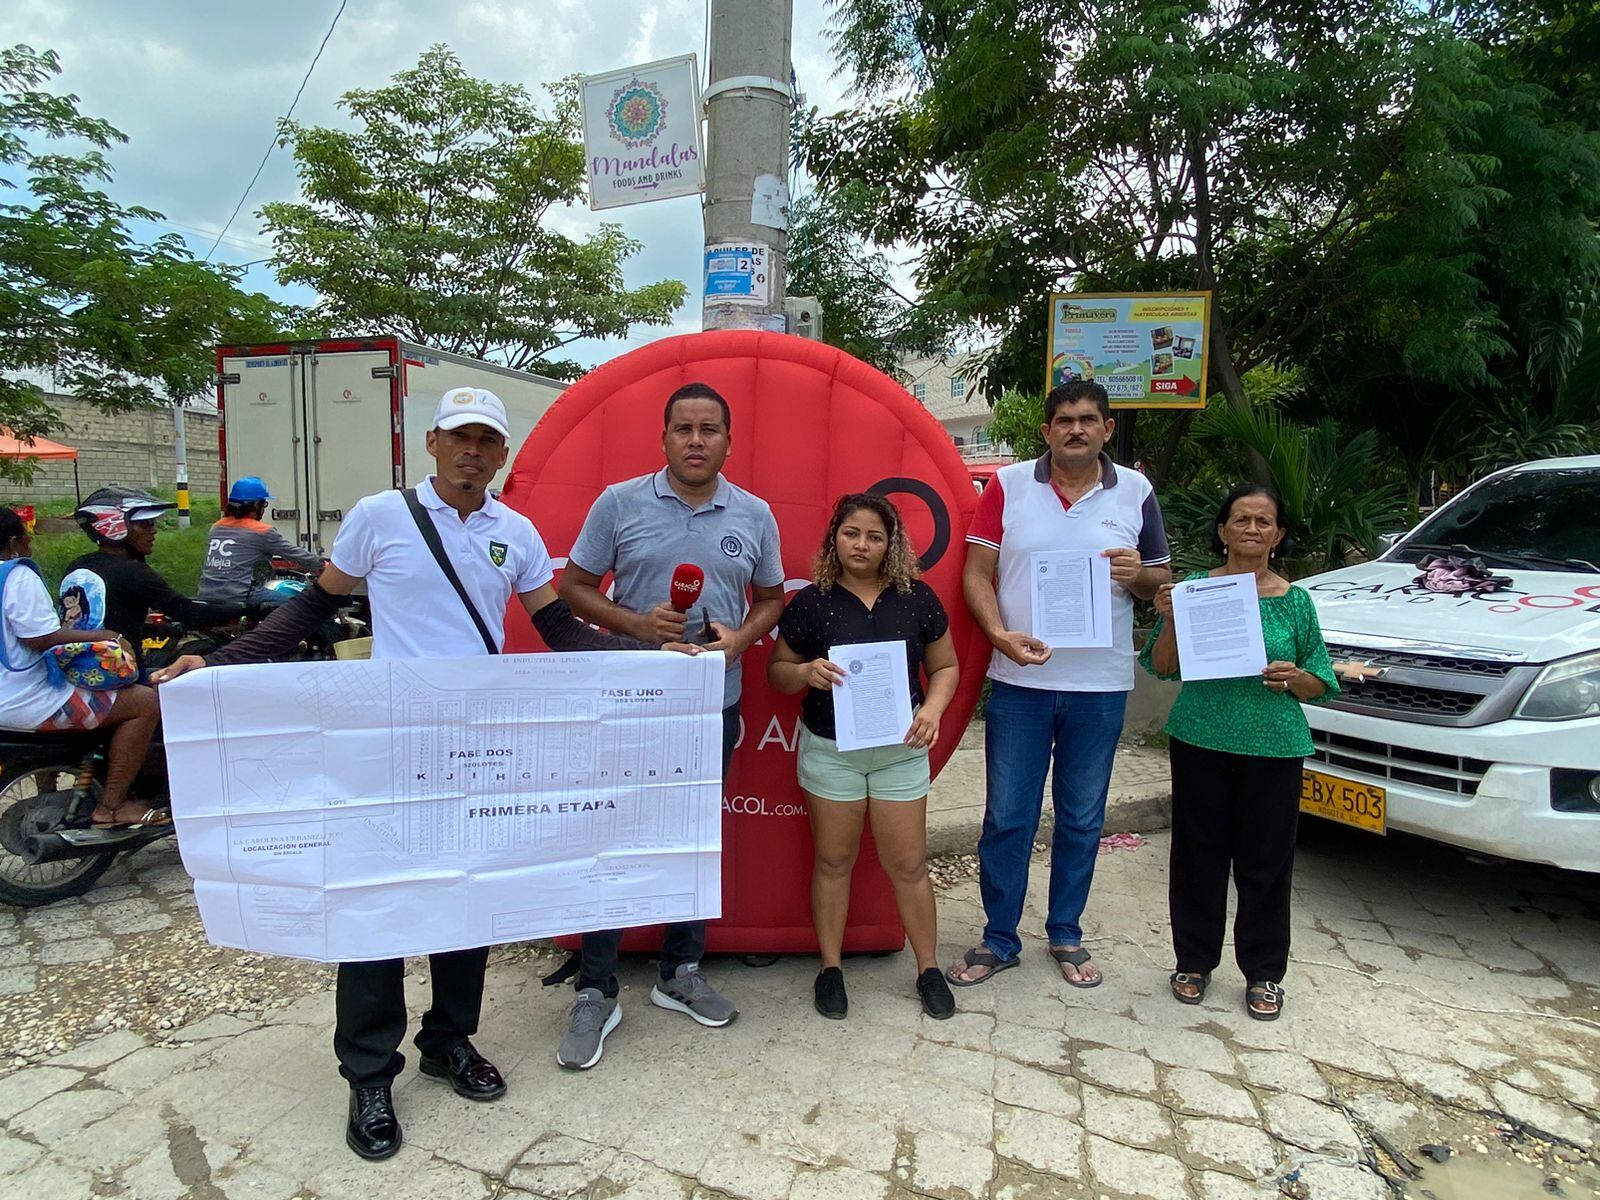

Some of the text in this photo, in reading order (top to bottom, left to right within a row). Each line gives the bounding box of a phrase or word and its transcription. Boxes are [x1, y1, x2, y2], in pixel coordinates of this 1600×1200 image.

[590, 143, 698, 176] Mandalas
[613, 170, 682, 189] FOODS AND DRINKS
[752, 247, 765, 256] DE
[1155, 381, 1178, 390] SIGA
[601, 688, 663, 697] FASE UNO
[449, 748, 513, 758] FASE DOS
[1342, 787, 1382, 819] 503
[469, 800, 616, 818] PRIMERA ETAPA
[243, 841, 331, 852] LOCALIZACION GENERAL
